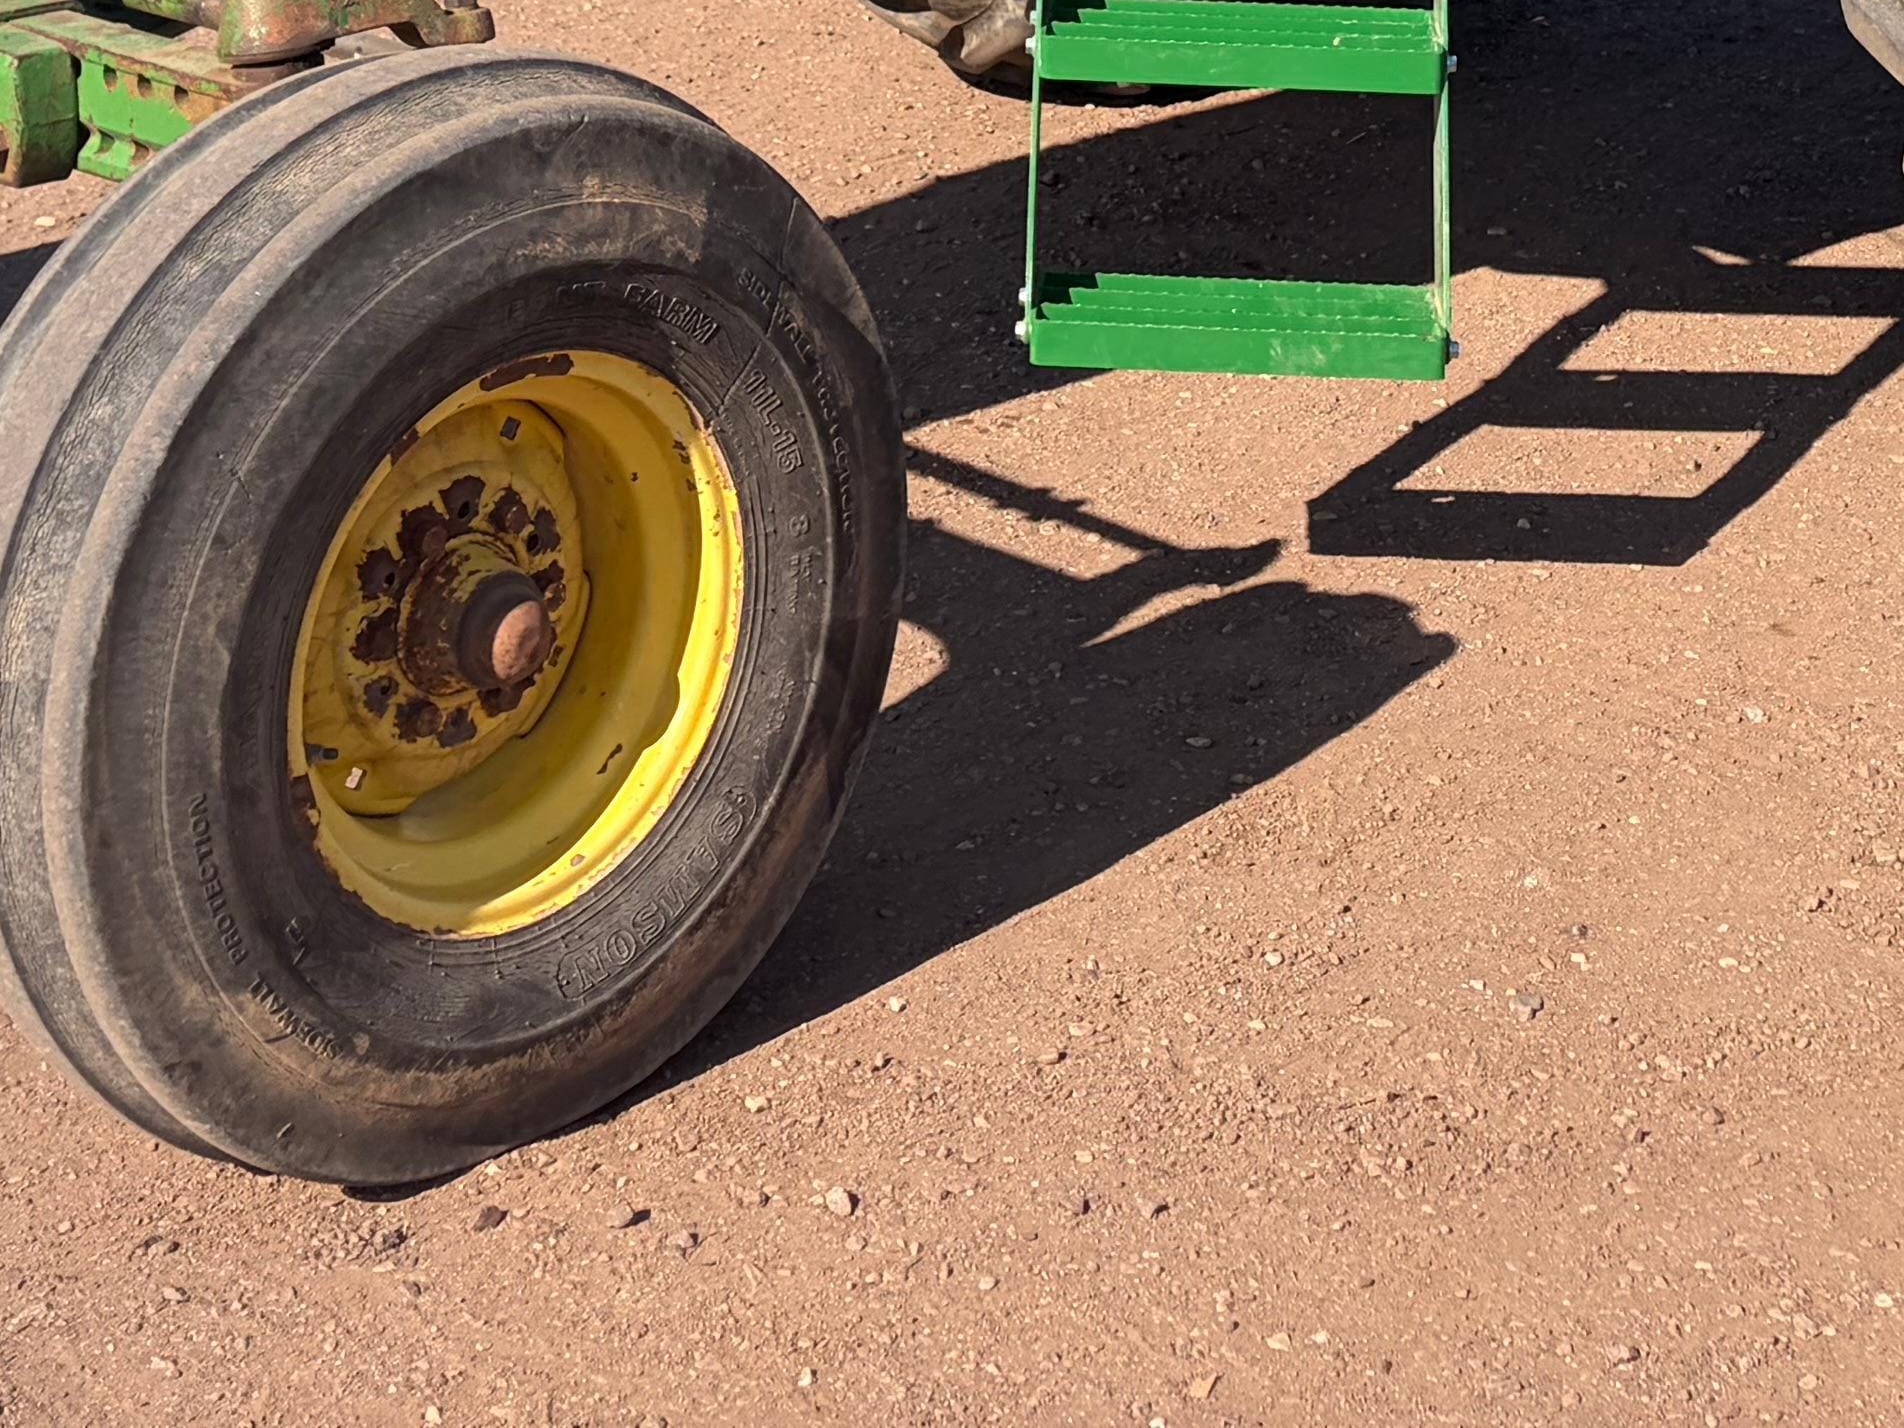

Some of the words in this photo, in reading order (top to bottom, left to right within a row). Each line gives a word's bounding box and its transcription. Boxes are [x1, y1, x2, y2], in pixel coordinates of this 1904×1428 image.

[189, 793, 248, 966] PROTECTION
[573, 799, 744, 992] SAMSON
[250, 970, 344, 1060] SIDEWALL
